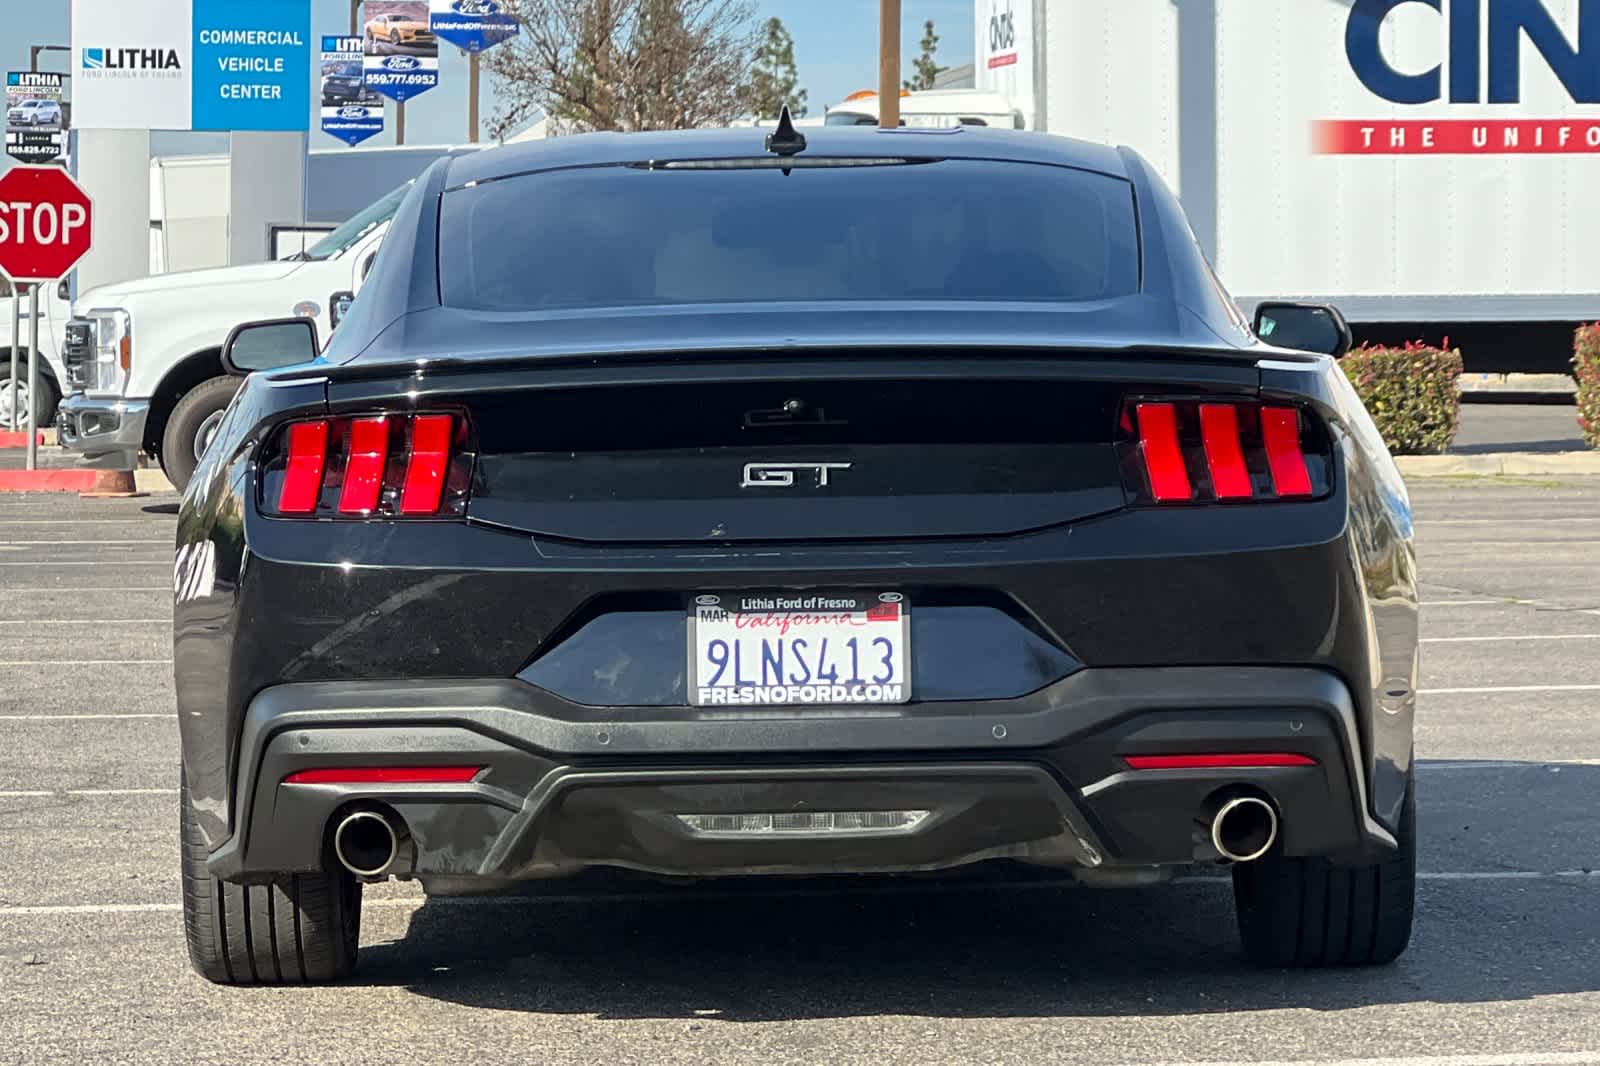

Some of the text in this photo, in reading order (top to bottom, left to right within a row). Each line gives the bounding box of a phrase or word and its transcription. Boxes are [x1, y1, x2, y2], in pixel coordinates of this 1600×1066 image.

[199, 29, 304, 45] COMMERCIAL
[105, 48, 181, 69] LITHIA
[1345, 0, 1600, 105] CIN
[217, 57, 285, 72] VEHICLE
[386, 57, 415, 69] Ford
[19, 73, 60, 86] LITHIA
[220, 84, 282, 99] CENTER
[1360, 126, 1600, 147] THE UNIFO
[743, 462, 852, 486] GT
[741, 598, 774, 609] Lithia
[776, 597, 803, 609] Ford
[803, 597, 817, 608] of
[818, 597, 857, 608] Fresno
[700, 609, 729, 623] MAR
[735, 611, 858, 635] California
[707, 636, 893, 686] 9LNS413
[698, 685, 902, 704] FRESNOFORD.COM
